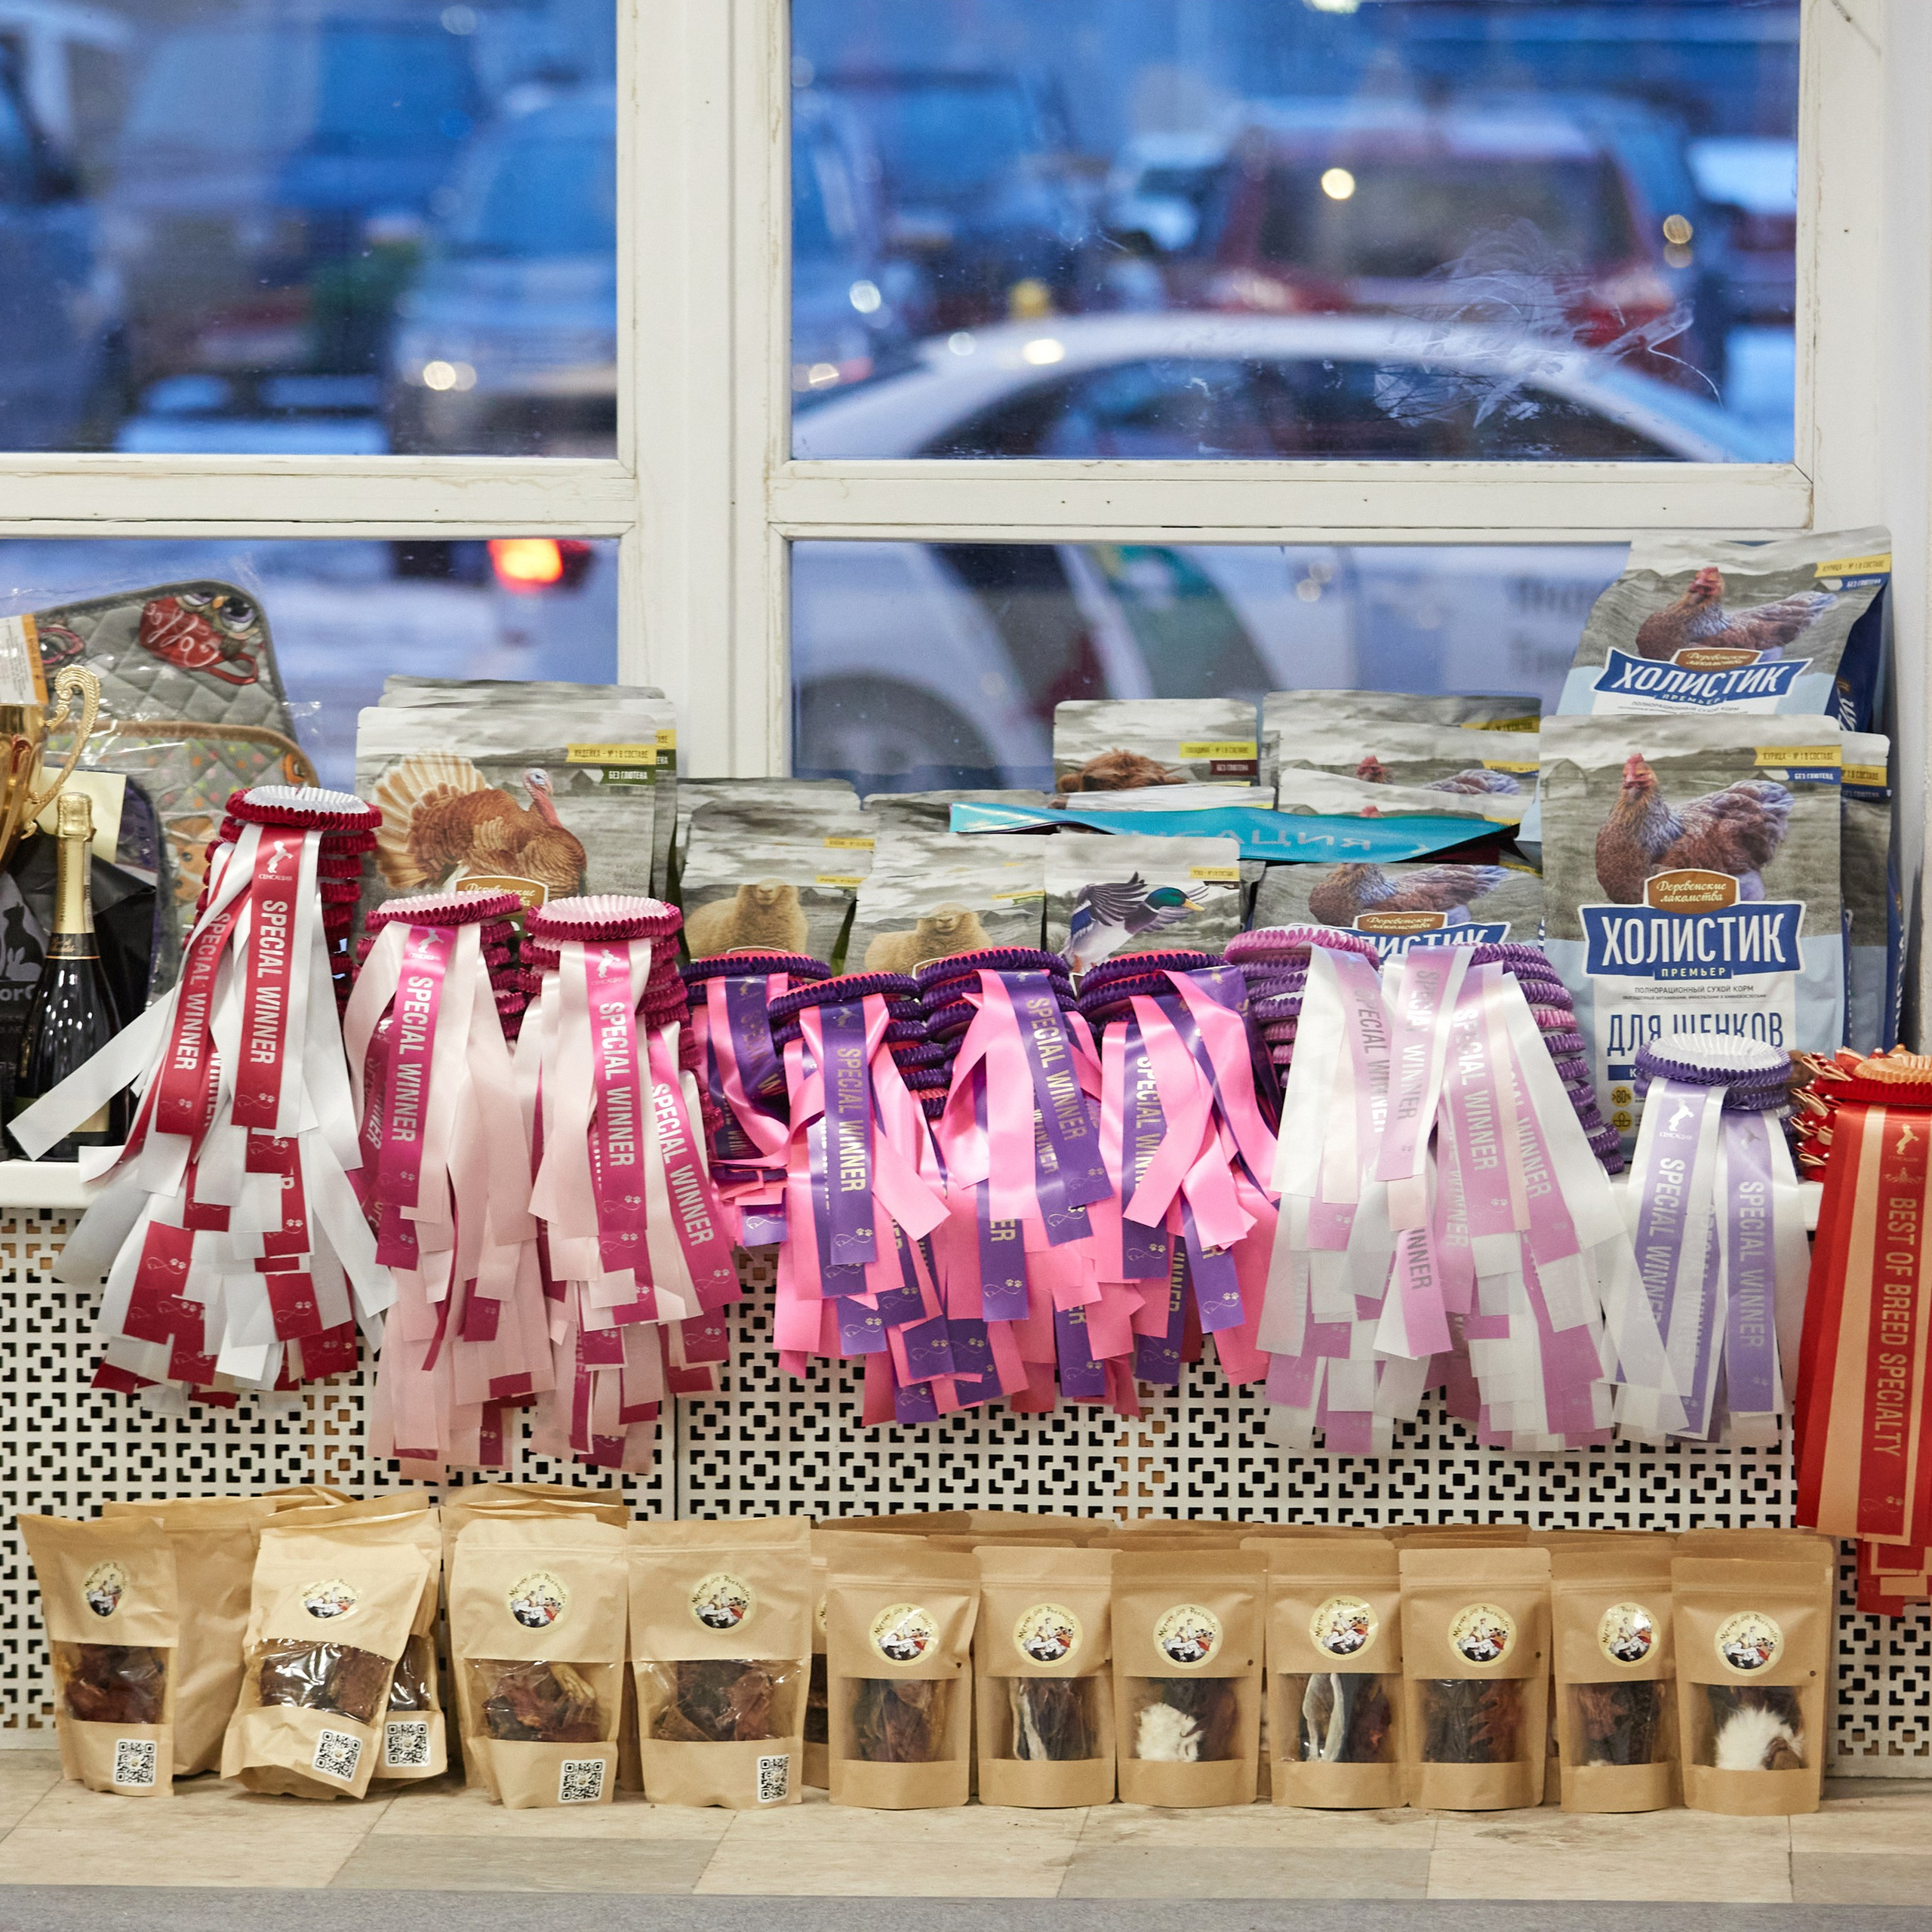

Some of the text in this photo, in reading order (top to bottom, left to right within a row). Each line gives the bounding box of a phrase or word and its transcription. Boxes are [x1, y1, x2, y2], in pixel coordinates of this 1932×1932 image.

[1611, 661, 1790, 698] ХОЛИСТИК
[1662, 694, 1724, 706] ПРЕМЬЕР
[1367, 916, 1435, 926] Деревенские
[1656, 881, 1727, 894] Деревенские
[1660, 891, 1724, 903] лакомства
[1600, 912, 1787, 967] ХОЛИСТИК
[1661, 967, 1727, 977] ПРЕМЬЕР
[174, 912, 232, 1070] SPECIAL WINNER
[251, 899, 288, 1065] SPECIAL WINNER
[1635, 986, 1705, 994] ПОЛНОРАЦИОННЫЙ
[1355, 987, 1388, 1054] SPECIAL
[1607, 1014, 1661, 1057] ДЛЯ
[391, 975, 435, 1143] SPECIAL WINNER
[598, 1001, 635, 1167] SPECIAL WINNER
[1026, 997, 1088, 1141] SPECIAL WINNER
[1397, 1043, 1426, 1121] WINNER
[837, 1048, 866, 1192] SPECIAL WINNER
[1463, 1090, 1499, 1171] WINNER
[651, 1082, 715, 1247] SPECIAL WINNER
[1518, 1116, 1552, 1199] WINNER
[1647, 1157, 1686, 1238] SPECIAL
[1887, 1197, 1918, 1246] BEST
[1407, 1229, 1432, 1291] INNER
[1739, 1180, 1765, 1349] SPECIAL WINNER
[1885, 1251, 1915, 1277] OF
[1881, 1284, 1912, 1346] BREED
[1873, 1352, 1908, 1457] SPECIALTY
